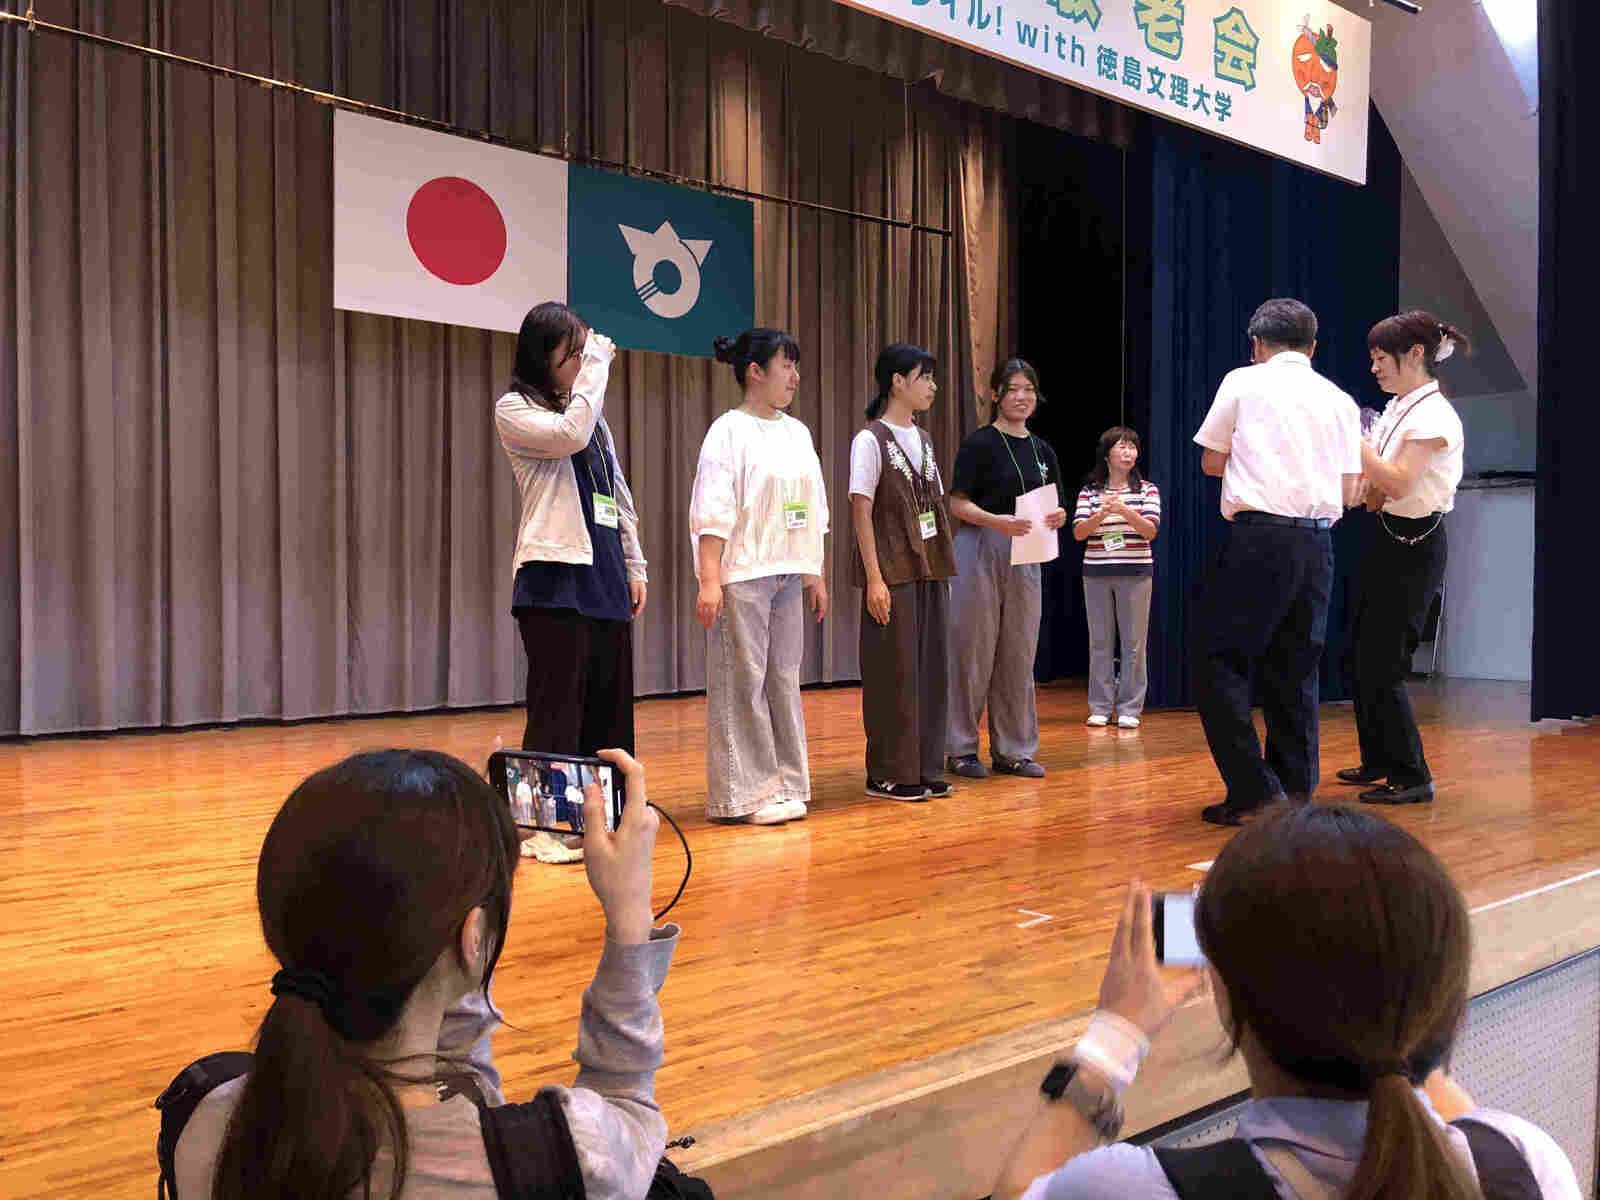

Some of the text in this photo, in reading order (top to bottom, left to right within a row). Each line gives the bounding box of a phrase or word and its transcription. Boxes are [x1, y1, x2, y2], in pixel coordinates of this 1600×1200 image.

[909, 0, 1232, 121] イル! with 徳島文理大学
